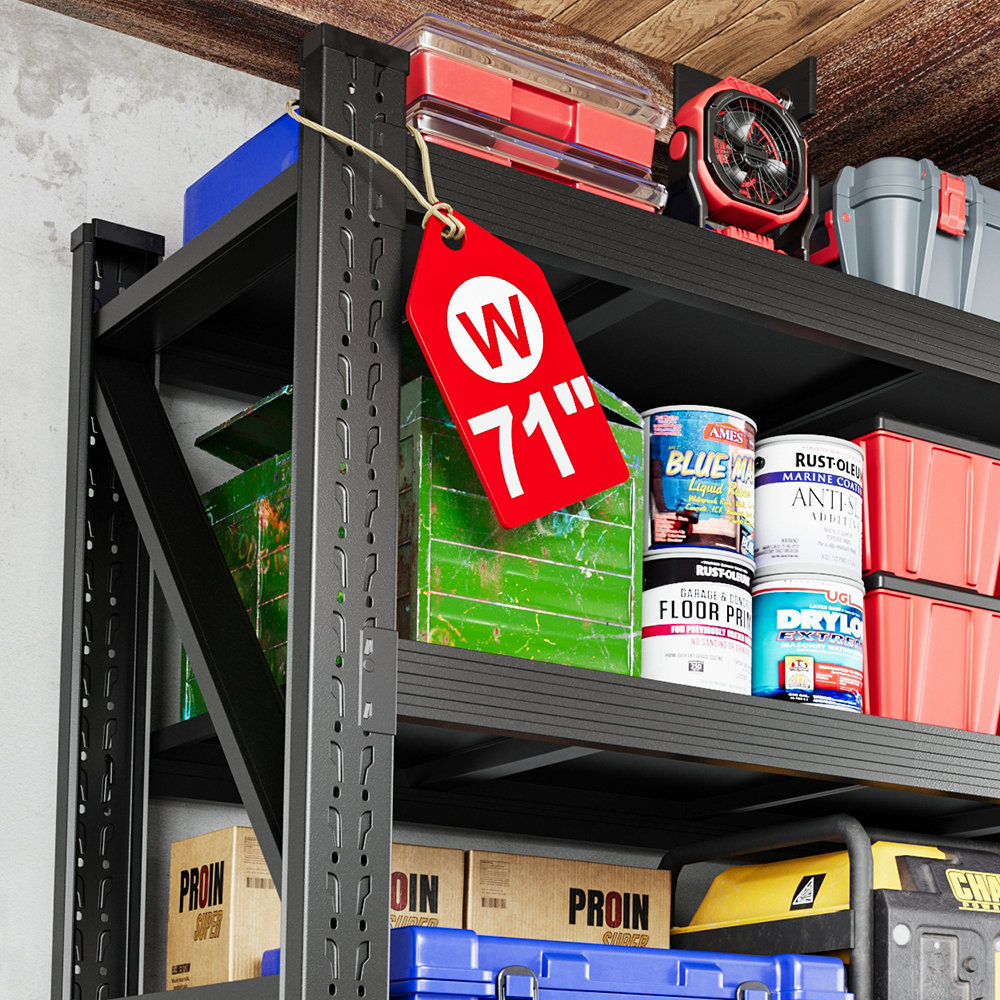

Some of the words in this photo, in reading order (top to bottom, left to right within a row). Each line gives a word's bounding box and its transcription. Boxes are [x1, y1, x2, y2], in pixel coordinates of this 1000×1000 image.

[456, 294, 532, 370] W
[467, 375, 594, 499] 71"
[709, 426, 743, 443] AMES
[666, 450, 729, 479] BLUE
[732, 456, 755, 483] MA
[783, 472, 833, 484] MARINE
[688, 477, 723, 497] Liquid
[792, 487, 860, 519] ANTI-SL
[680, 588, 717, 600] GARAGE
[826, 590, 854, 606] UGL
[659, 600, 719, 621] FLOOR
[776, 608, 863, 639] DRYLO
[776, 630, 863, 651] EXTRE
[780, 642, 828, 650] MASONRY
[179, 861, 225, 914] PROIN
[391, 871, 439, 914] OIN
[568, 887, 649, 931] PROIN
[193, 910, 224, 941] SUPER
